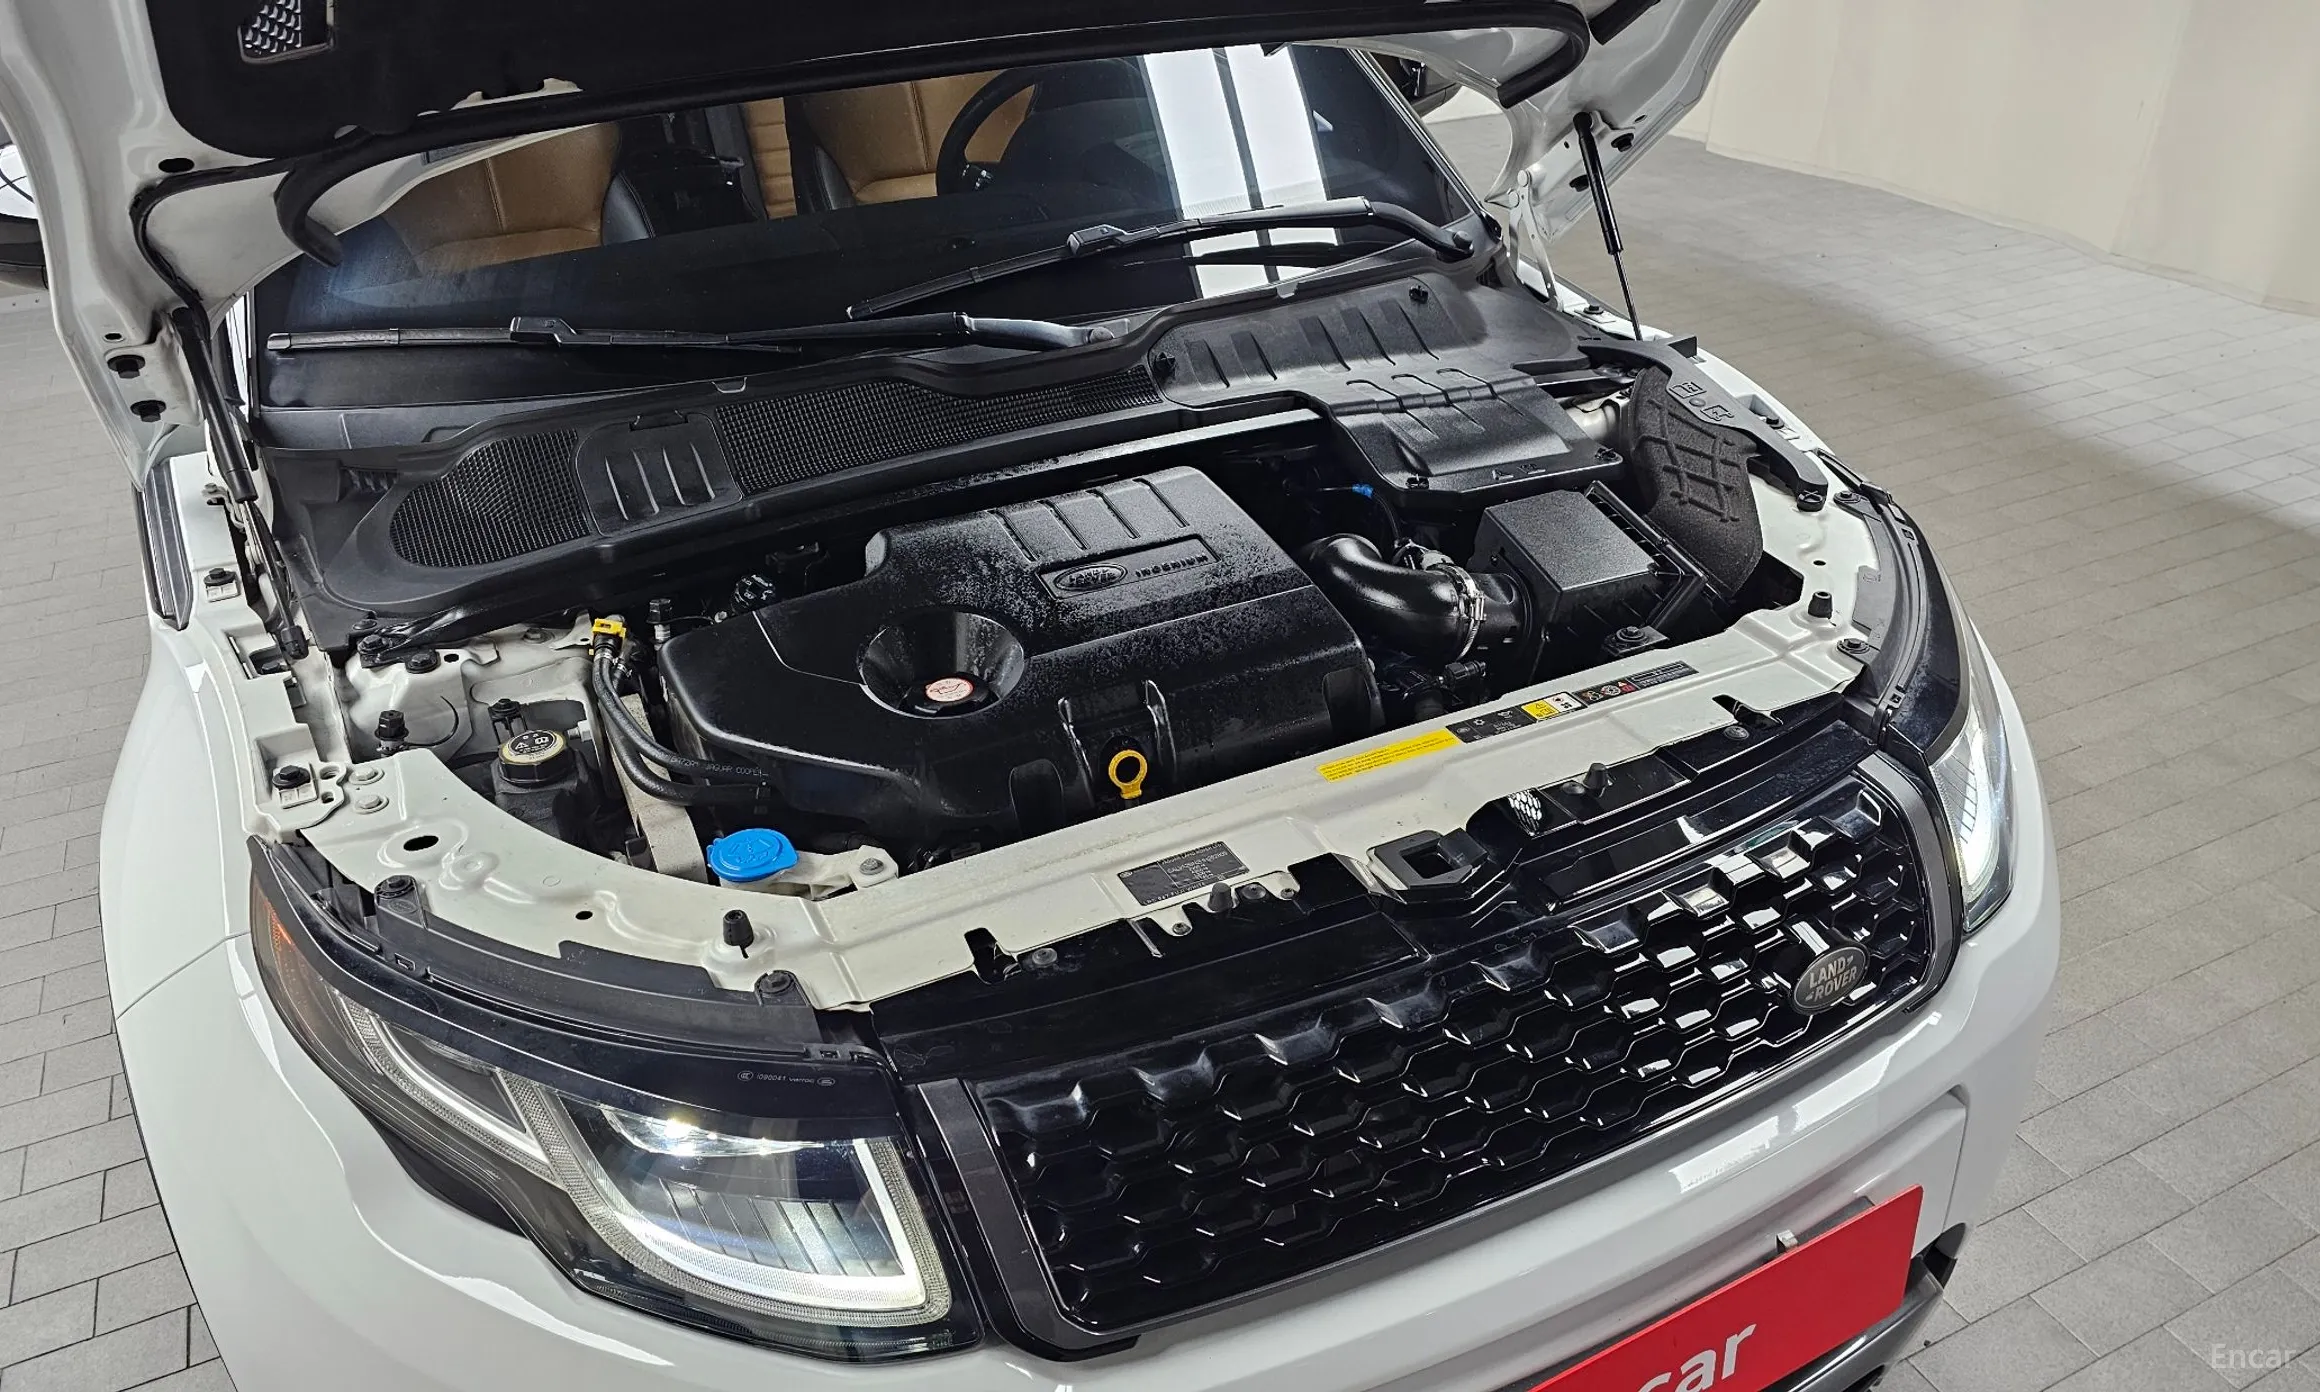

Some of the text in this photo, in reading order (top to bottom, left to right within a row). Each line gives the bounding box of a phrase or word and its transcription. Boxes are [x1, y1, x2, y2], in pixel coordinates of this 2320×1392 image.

[1135, 554, 1209, 578] INGENIUM
[1809, 956, 1846, 989] LAND
[1814, 966, 1857, 1002] ROVER
